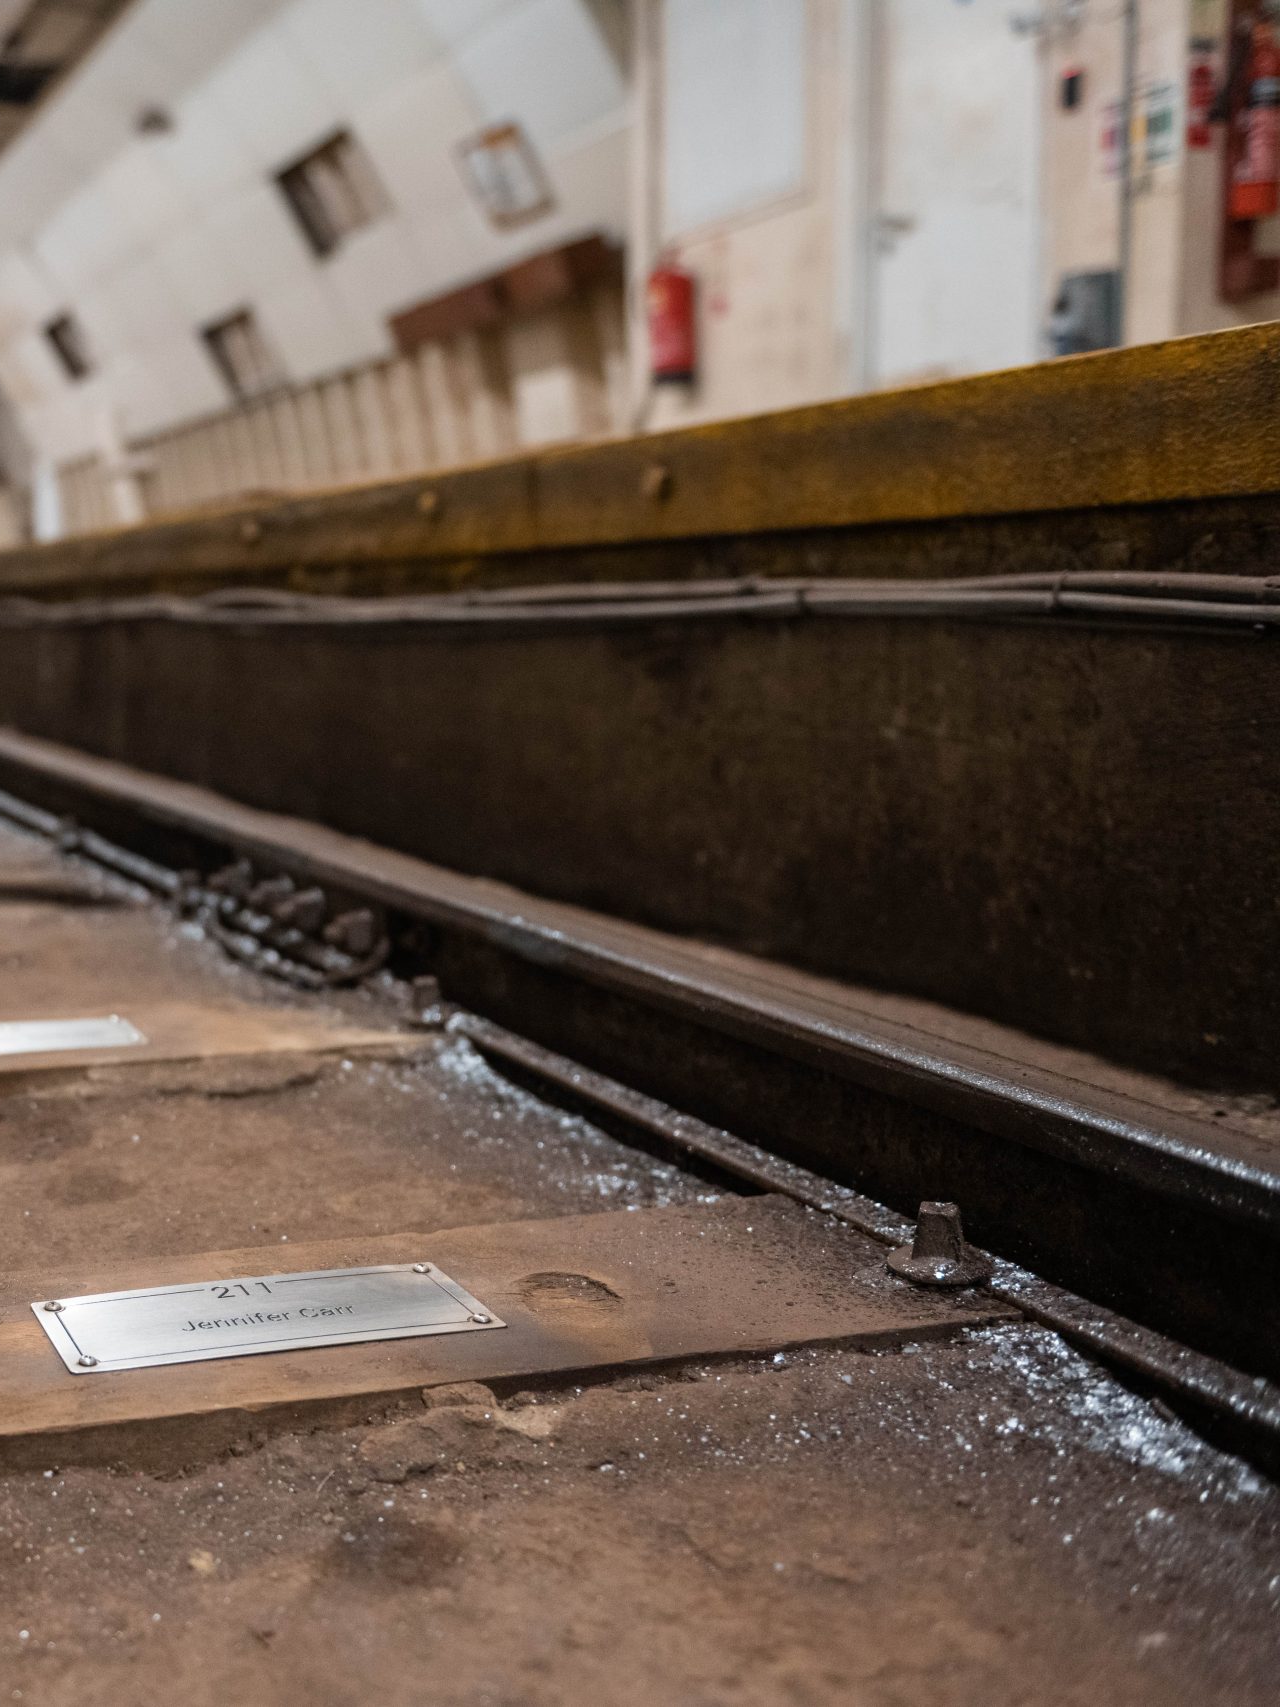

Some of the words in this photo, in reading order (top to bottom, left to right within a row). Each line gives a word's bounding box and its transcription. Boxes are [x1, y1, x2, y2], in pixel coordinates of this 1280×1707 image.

[211, 1281, 273, 1299] 211
[182, 1311, 291, 1332] Jennifer
[299, 1304, 355, 1319] Carr
